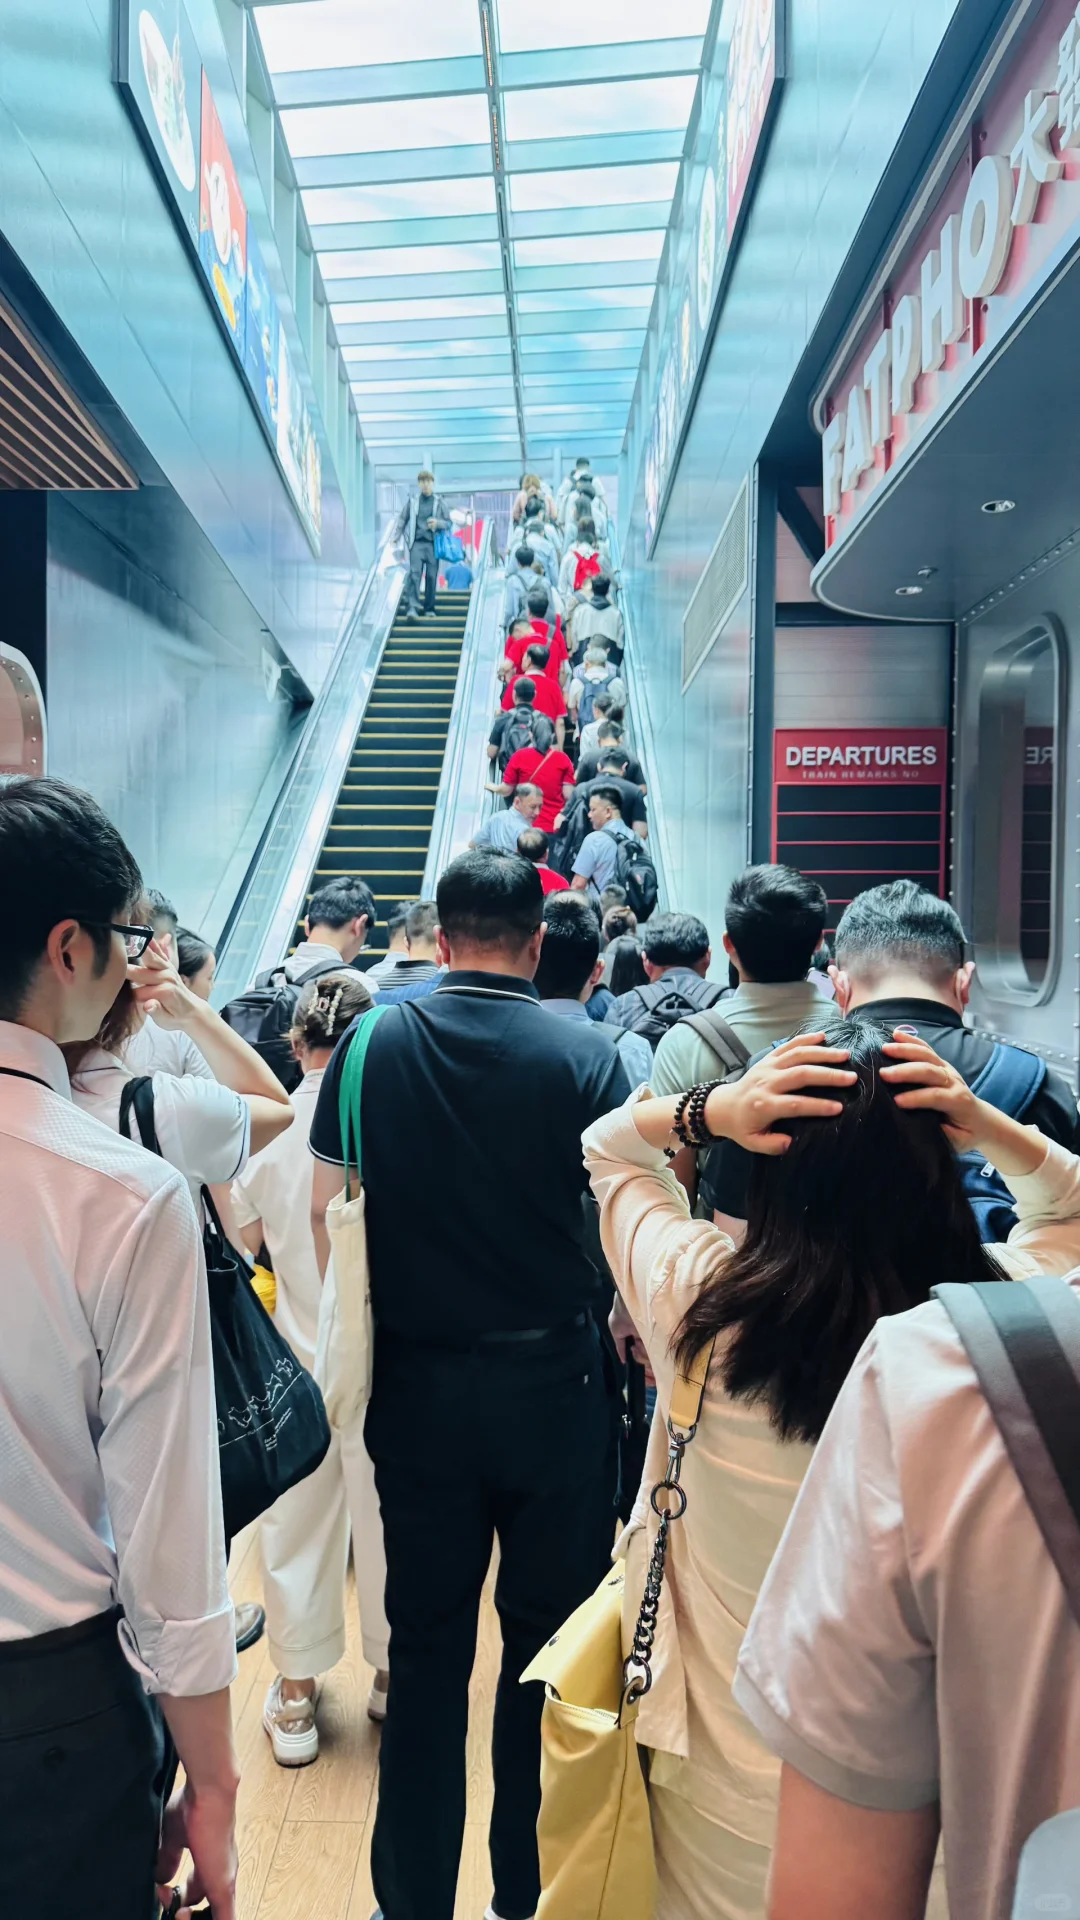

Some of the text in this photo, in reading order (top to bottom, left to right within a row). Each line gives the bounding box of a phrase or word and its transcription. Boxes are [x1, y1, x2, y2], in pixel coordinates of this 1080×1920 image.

[823, 156, 1012, 515] FATPHO
[786, 746, 937, 766] DEPARTURES
[802, 770, 836, 779] TRAIN
[841, 770, 897, 779] REMARKS
